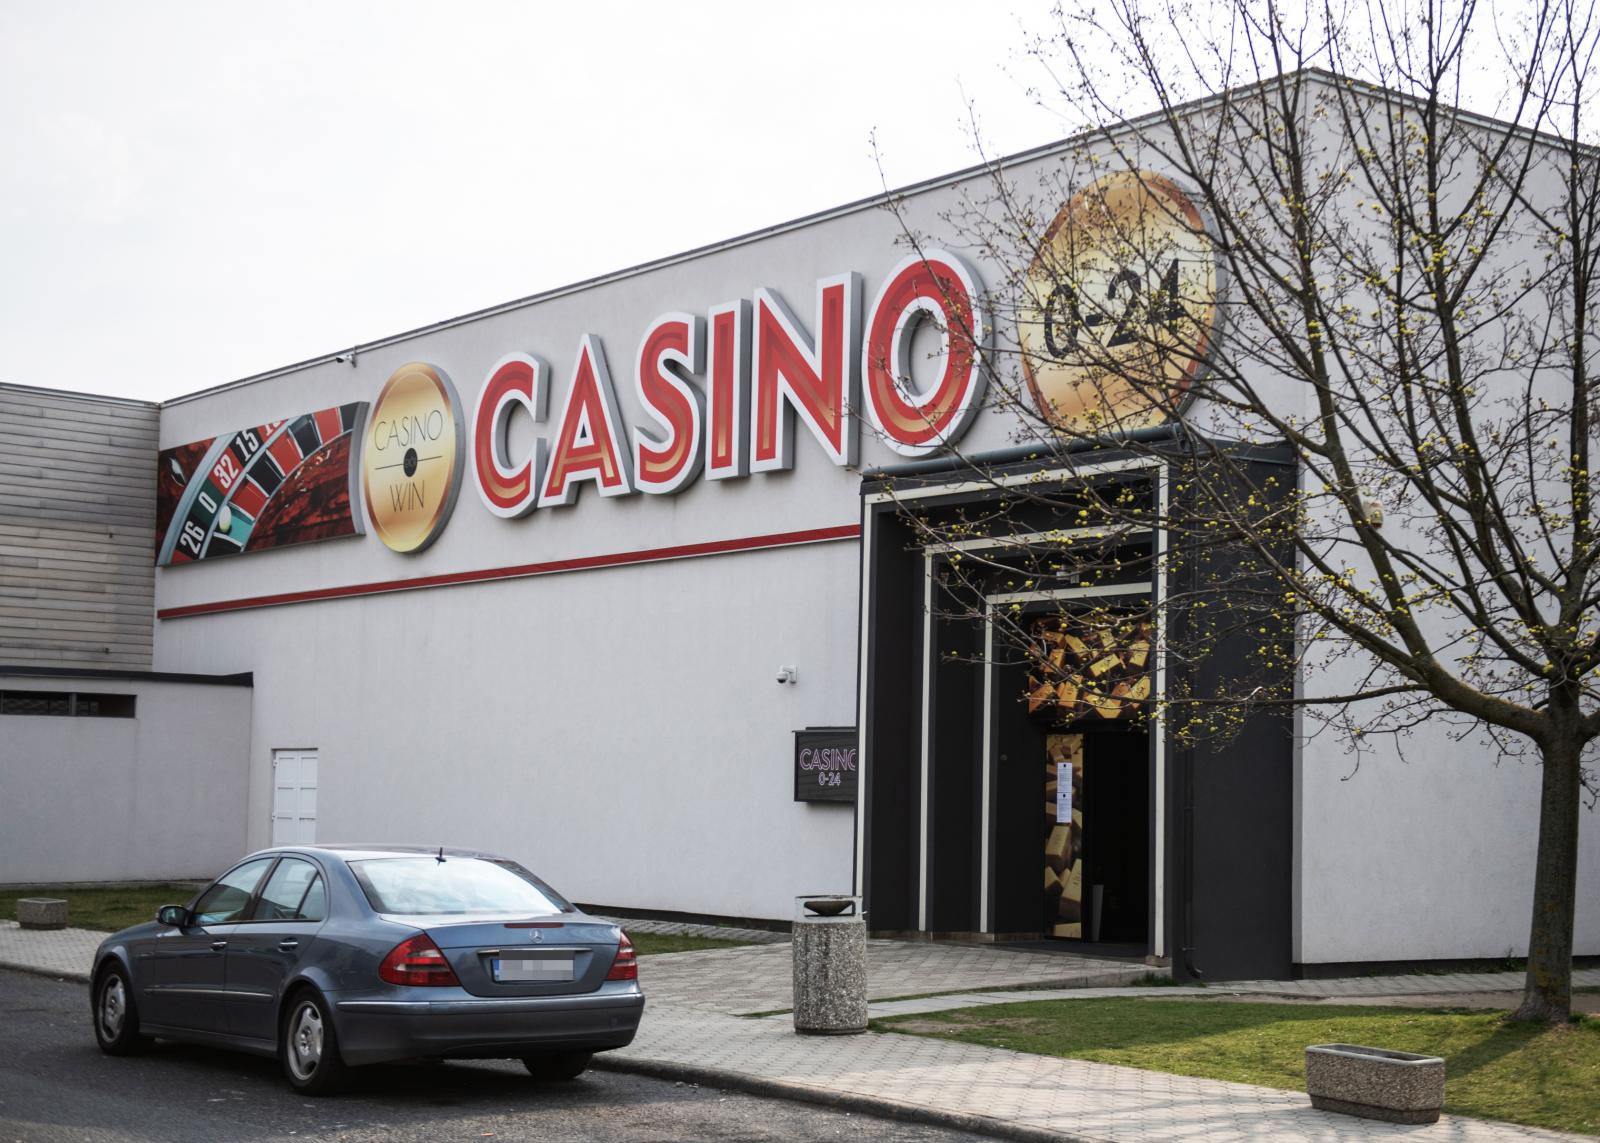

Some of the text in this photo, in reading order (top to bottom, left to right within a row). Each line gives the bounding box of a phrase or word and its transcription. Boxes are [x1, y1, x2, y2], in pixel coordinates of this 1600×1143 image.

[1044, 257, 1187, 359] 0-24
[471, 248, 987, 520] CASINO
[235, 430, 260, 462] 15
[374, 409, 444, 451] CASINO
[213, 454, 239, 489] 32
[198, 491, 218, 514] 0
[389, 480, 425, 512] WIN
[180, 520, 205, 555] 26
[818, 771, 842, 786] 0-24
